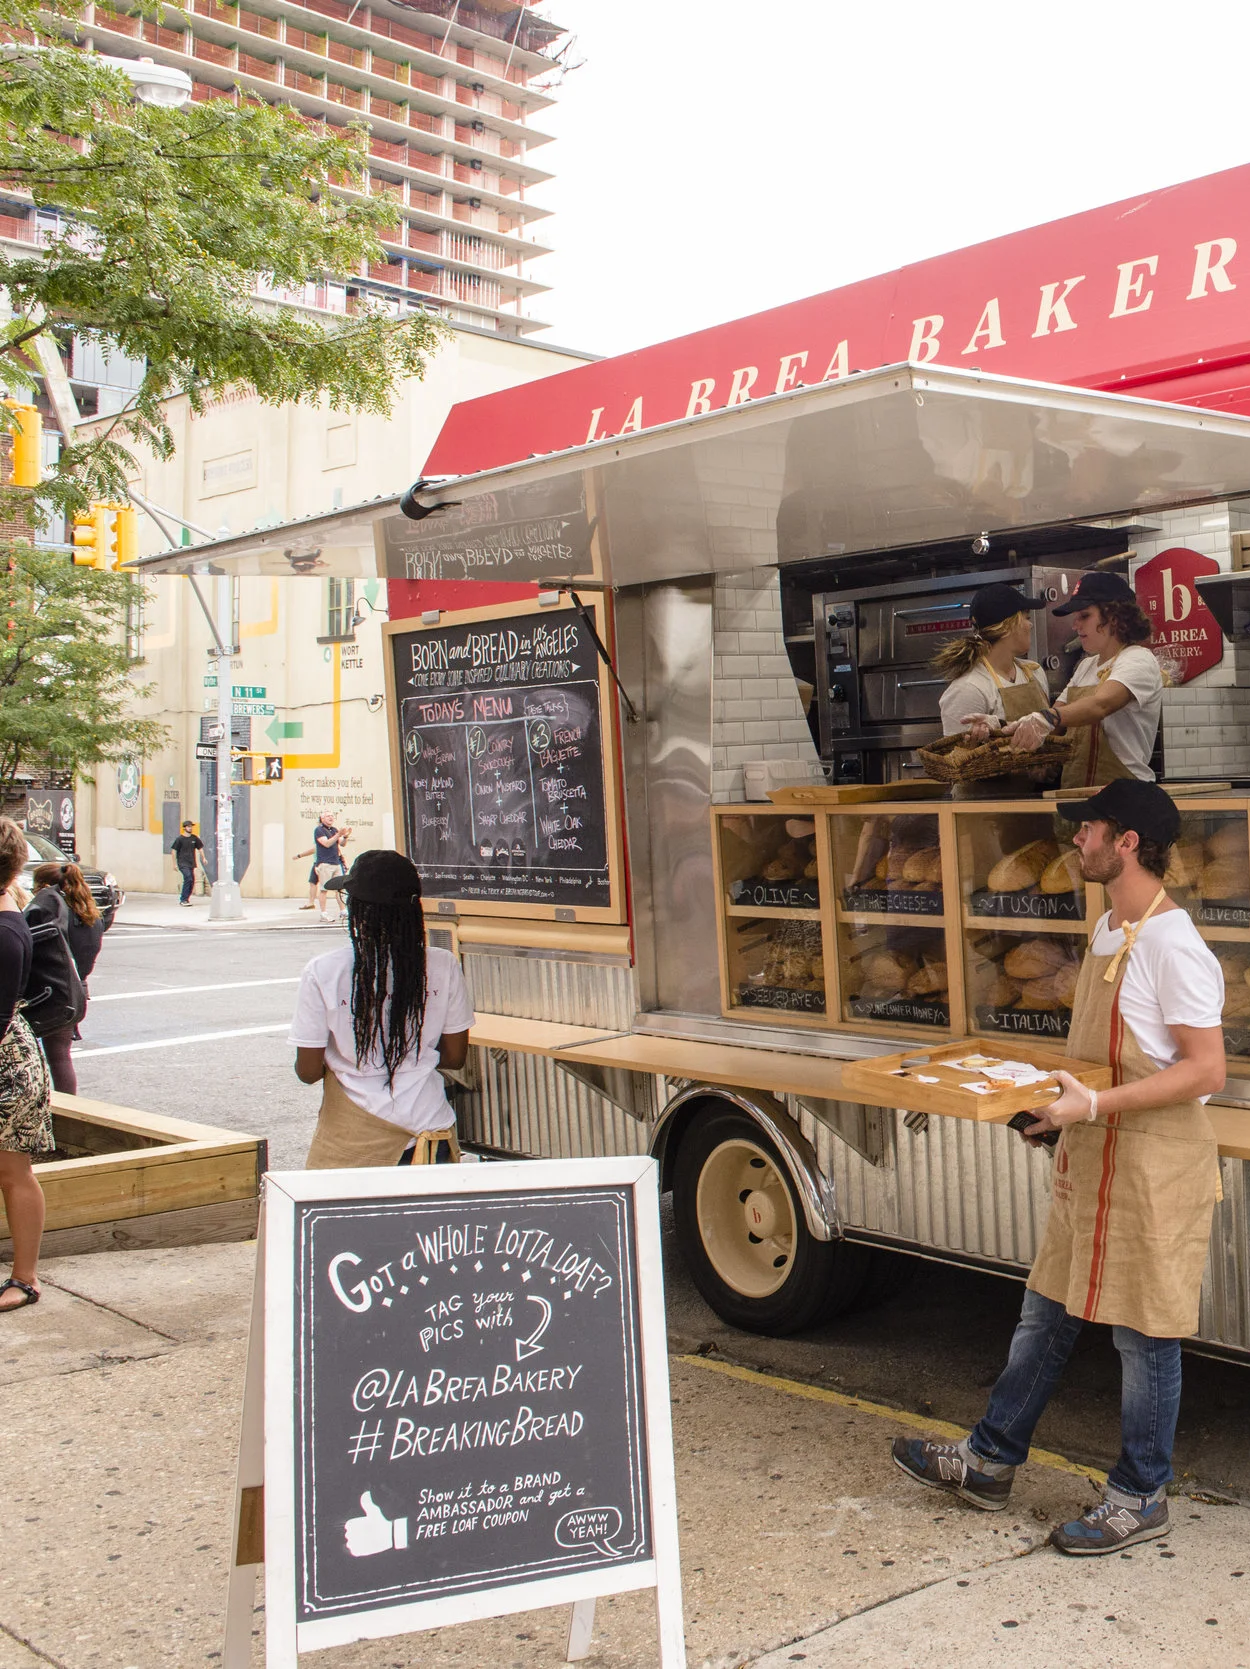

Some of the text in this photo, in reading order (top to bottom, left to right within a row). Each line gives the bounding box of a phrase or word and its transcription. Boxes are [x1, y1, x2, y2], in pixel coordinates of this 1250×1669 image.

[584, 396, 643, 443] LA
[685, 339, 853, 419] BREA
[1149, 600, 1157, 611] 19
[1151, 627, 1208, 644] LA BREA
[341, 645, 359, 656] WORT
[411, 624, 579, 672] BORN and BREAD in LOS ANGELES
[341, 659, 363, 669] KETTLE
[494, 661, 532, 683] CULINARY
[532, 659, 571, 680] CREATIONS
[235, 687, 242, 697] N
[244, 687, 253, 698] 11
[234, 704, 265, 715] BREWERS
[418, 695, 513, 723] TODAY'S MENU
[469, 730, 485, 757] #2
[532, 724, 549, 748] #3
[553, 726, 582, 745] FRENCH
[202, 748, 216, 756] ONE
[539, 746, 582, 768] BAGUETTE
[316, 776, 336, 788] makes
[337, 779, 349, 790] you
[350, 776, 363, 788] feel
[495, 780, 527, 794] MUSTARD
[539, 778, 567, 792] TOMATO
[164, 790, 179, 799] FILTER
[300, 792, 374, 806] the way you ought to feel
[500, 810, 528, 825] CHEDDAR
[539, 815, 583, 835] WHITE OAK
[548, 835, 583, 851] CHEDDAR
[754, 885, 799, 905] OLIVE
[992, 895, 1058, 916] TUSCAN
[866, 1004, 912, 1017] SUNFLOWER
[999, 1013, 1061, 1032] ITALIAN
[753, 1207, 762, 1224] b
[327, 1221, 613, 1313] GOT a WHOLE LOTTA LOAF?
[424, 1290, 515, 1323] TAG your
[418, 1307, 513, 1353] PICS with
[351, 1364, 584, 1413] @LABREABAKERY
[418, 1471, 562, 1505] Show it to a BRAND
[416, 1482, 586, 1522] AMBASSADOR and get a
[415, 1508, 530, 1540] FREE LOAF COUPON
[566, 1513, 609, 1527] AWWW
[569, 1523, 608, 1539] YEAH!
